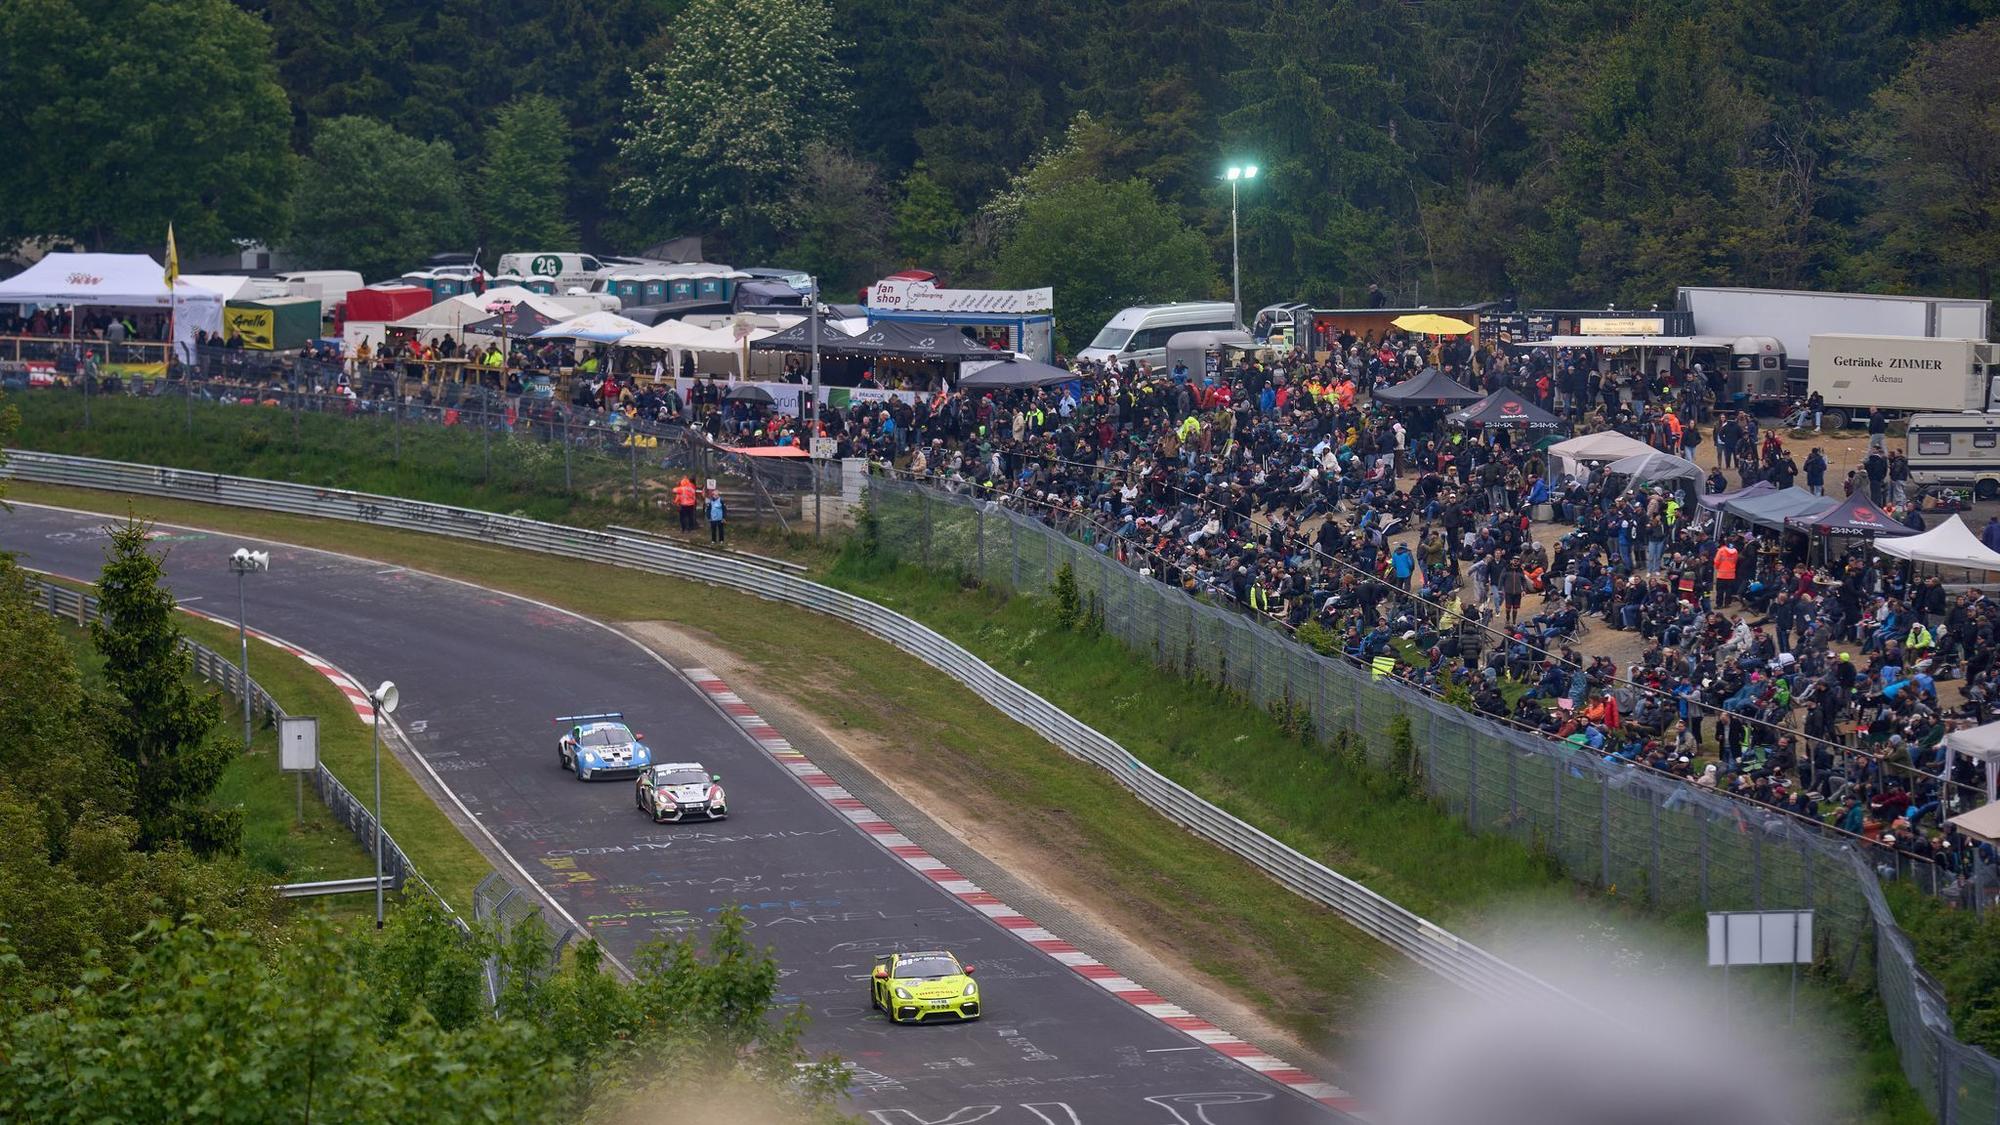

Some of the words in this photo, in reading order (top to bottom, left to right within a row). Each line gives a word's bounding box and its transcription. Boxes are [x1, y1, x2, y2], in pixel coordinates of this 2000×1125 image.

[537, 257, 557, 276] 2G
[877, 283, 894, 295] fan
[876, 295, 901, 305] shop
[232, 314, 266, 328] Grello
[1834, 356, 1883, 368] Getränke
[1889, 358, 1942, 370] ZIMMER
[1872, 374, 1903, 383] Adenau
[1831, 527, 1864, 535] 24MX
[650, 875, 762, 887] TEAM
